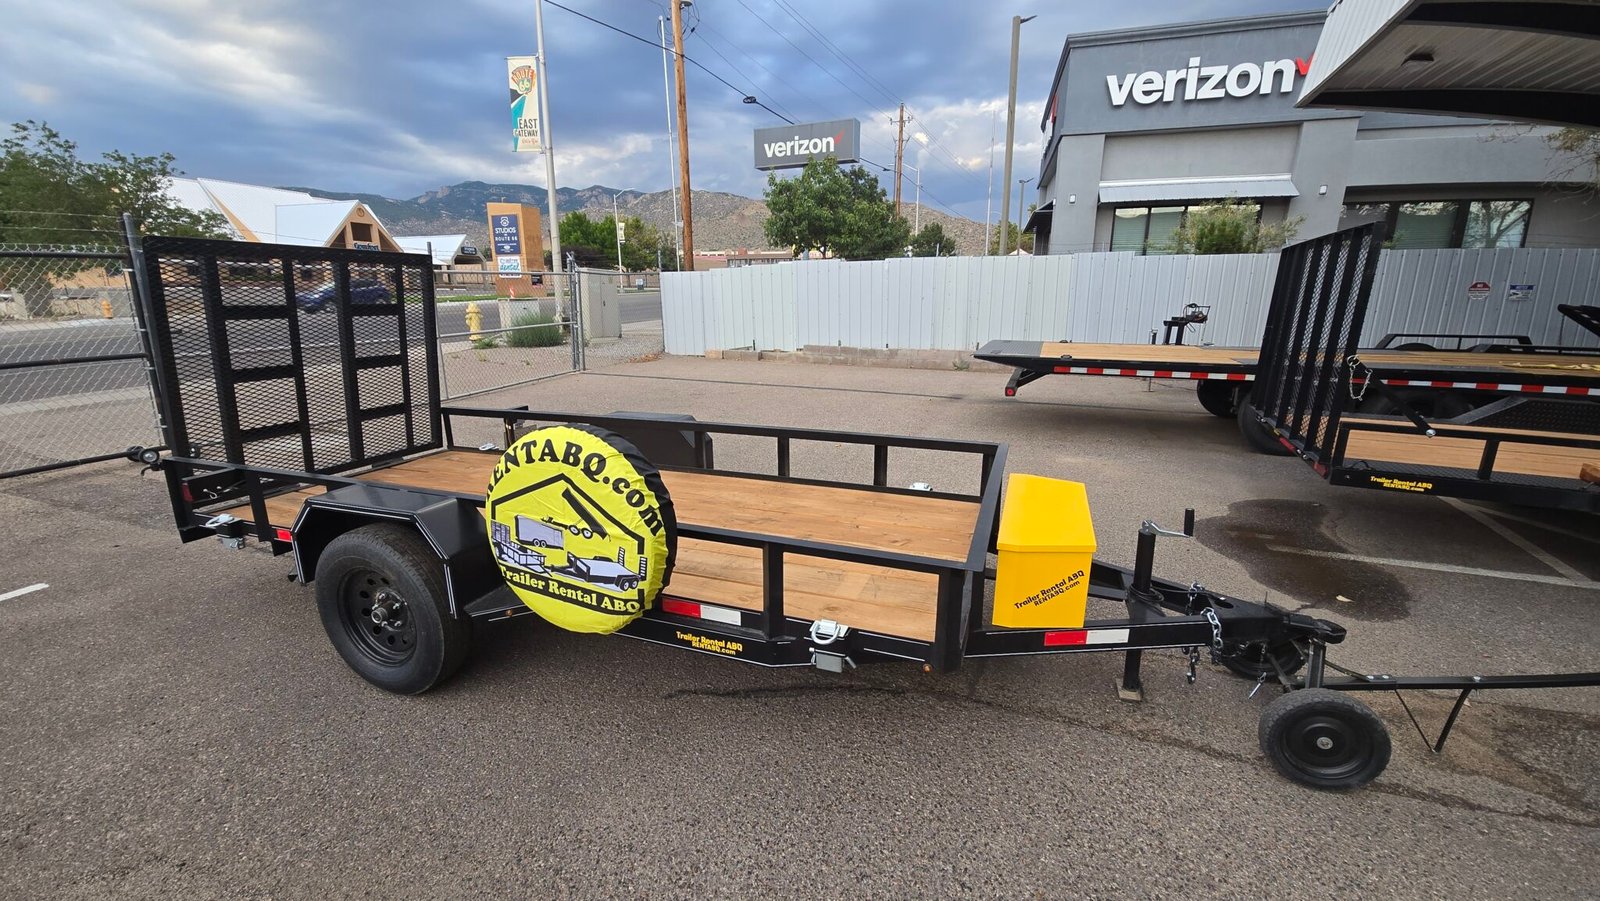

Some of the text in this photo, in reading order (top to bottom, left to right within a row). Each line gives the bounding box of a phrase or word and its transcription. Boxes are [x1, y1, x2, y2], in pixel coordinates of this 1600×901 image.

[511, 69, 535, 85] ROUTE
[519, 79, 530, 91] 66
[1106, 56, 1296, 106] verizon
[519, 118, 538, 129] EAST
[763, 135, 835, 158] verizon
[501, 566, 545, 590] Trailer
[549, 580, 597, 606] Rental
[1014, 569, 1085, 609] Trailer Rental ABQ
[1033, 580, 1080, 607] RENTABQ.com
[676, 631, 743, 652] Trailer Rental ABQ
[692, 642, 736, 655] RENTABQ.com
